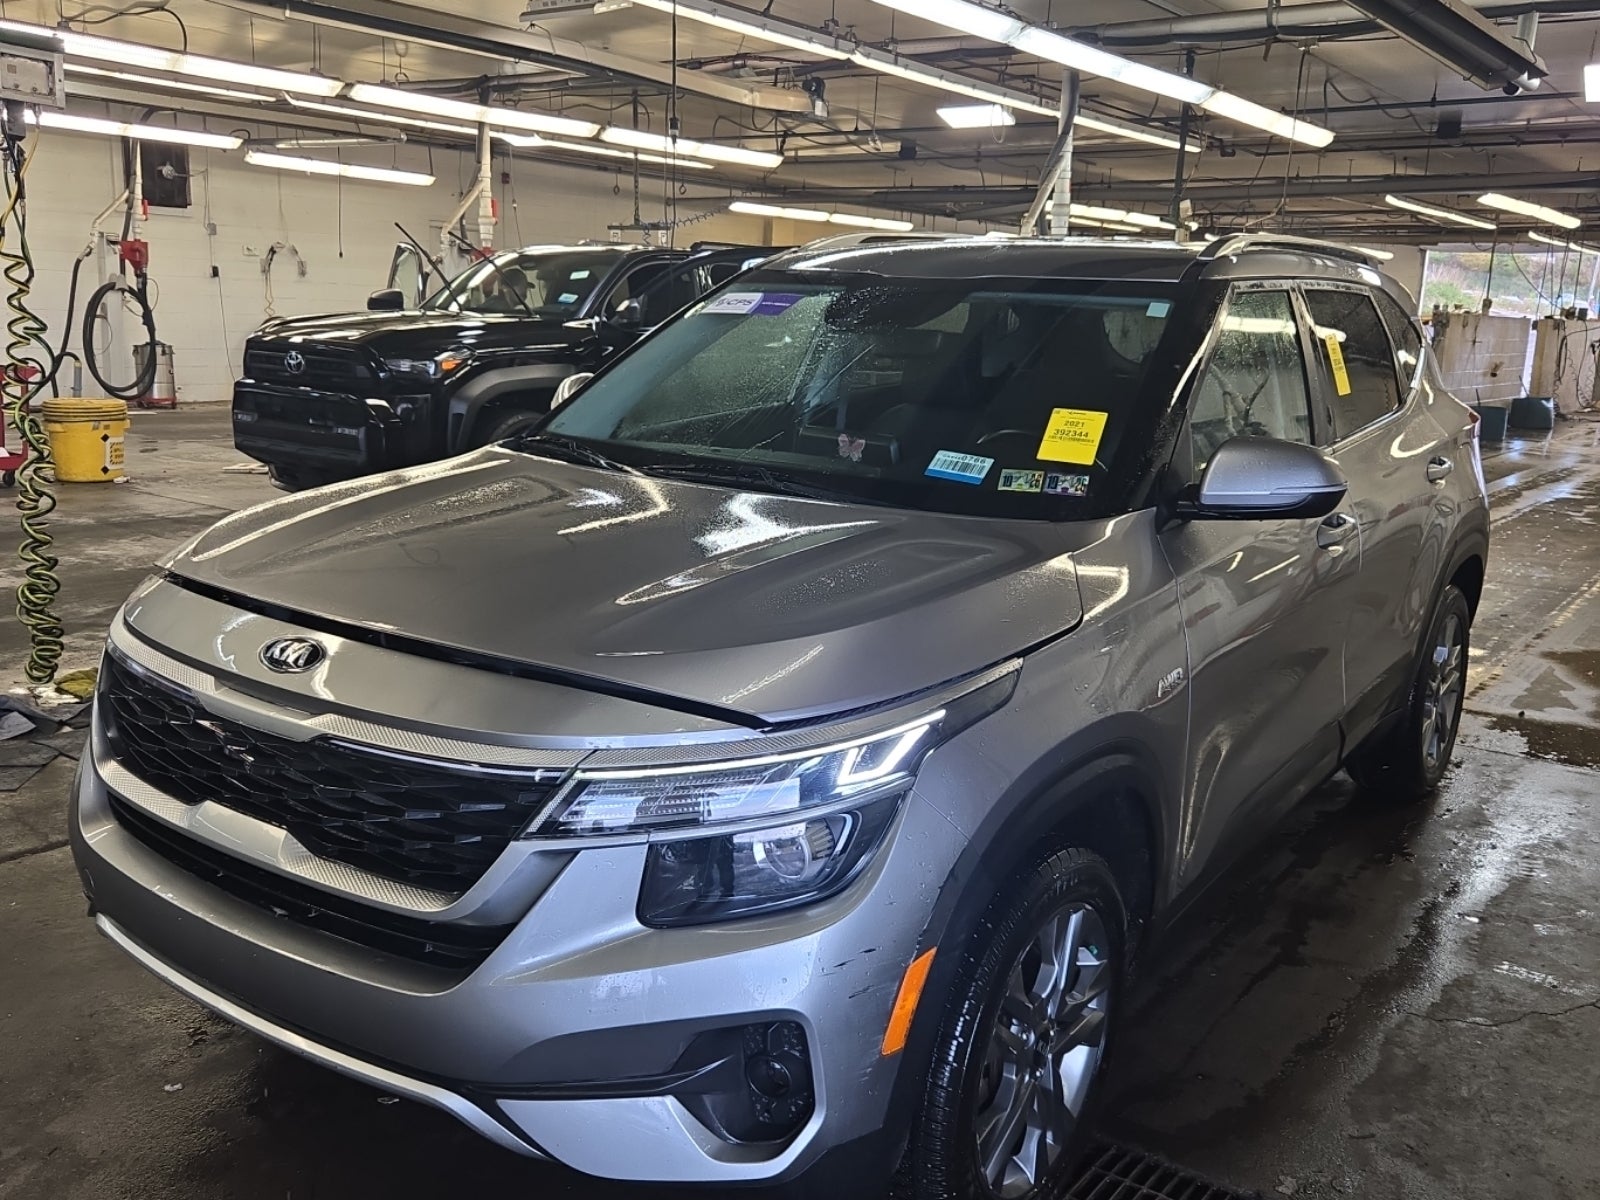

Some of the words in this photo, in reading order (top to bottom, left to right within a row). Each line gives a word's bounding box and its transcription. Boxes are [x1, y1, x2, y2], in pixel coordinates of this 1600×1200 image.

[1064, 420, 1085, 428] 2021
[1053, 428, 1089, 438] 392344
[1003, 475, 1013, 488] 10
[1048, 475, 1060, 490] 10
[265, 640, 313, 669] KIA
[1157, 667, 1184, 698] AWD
